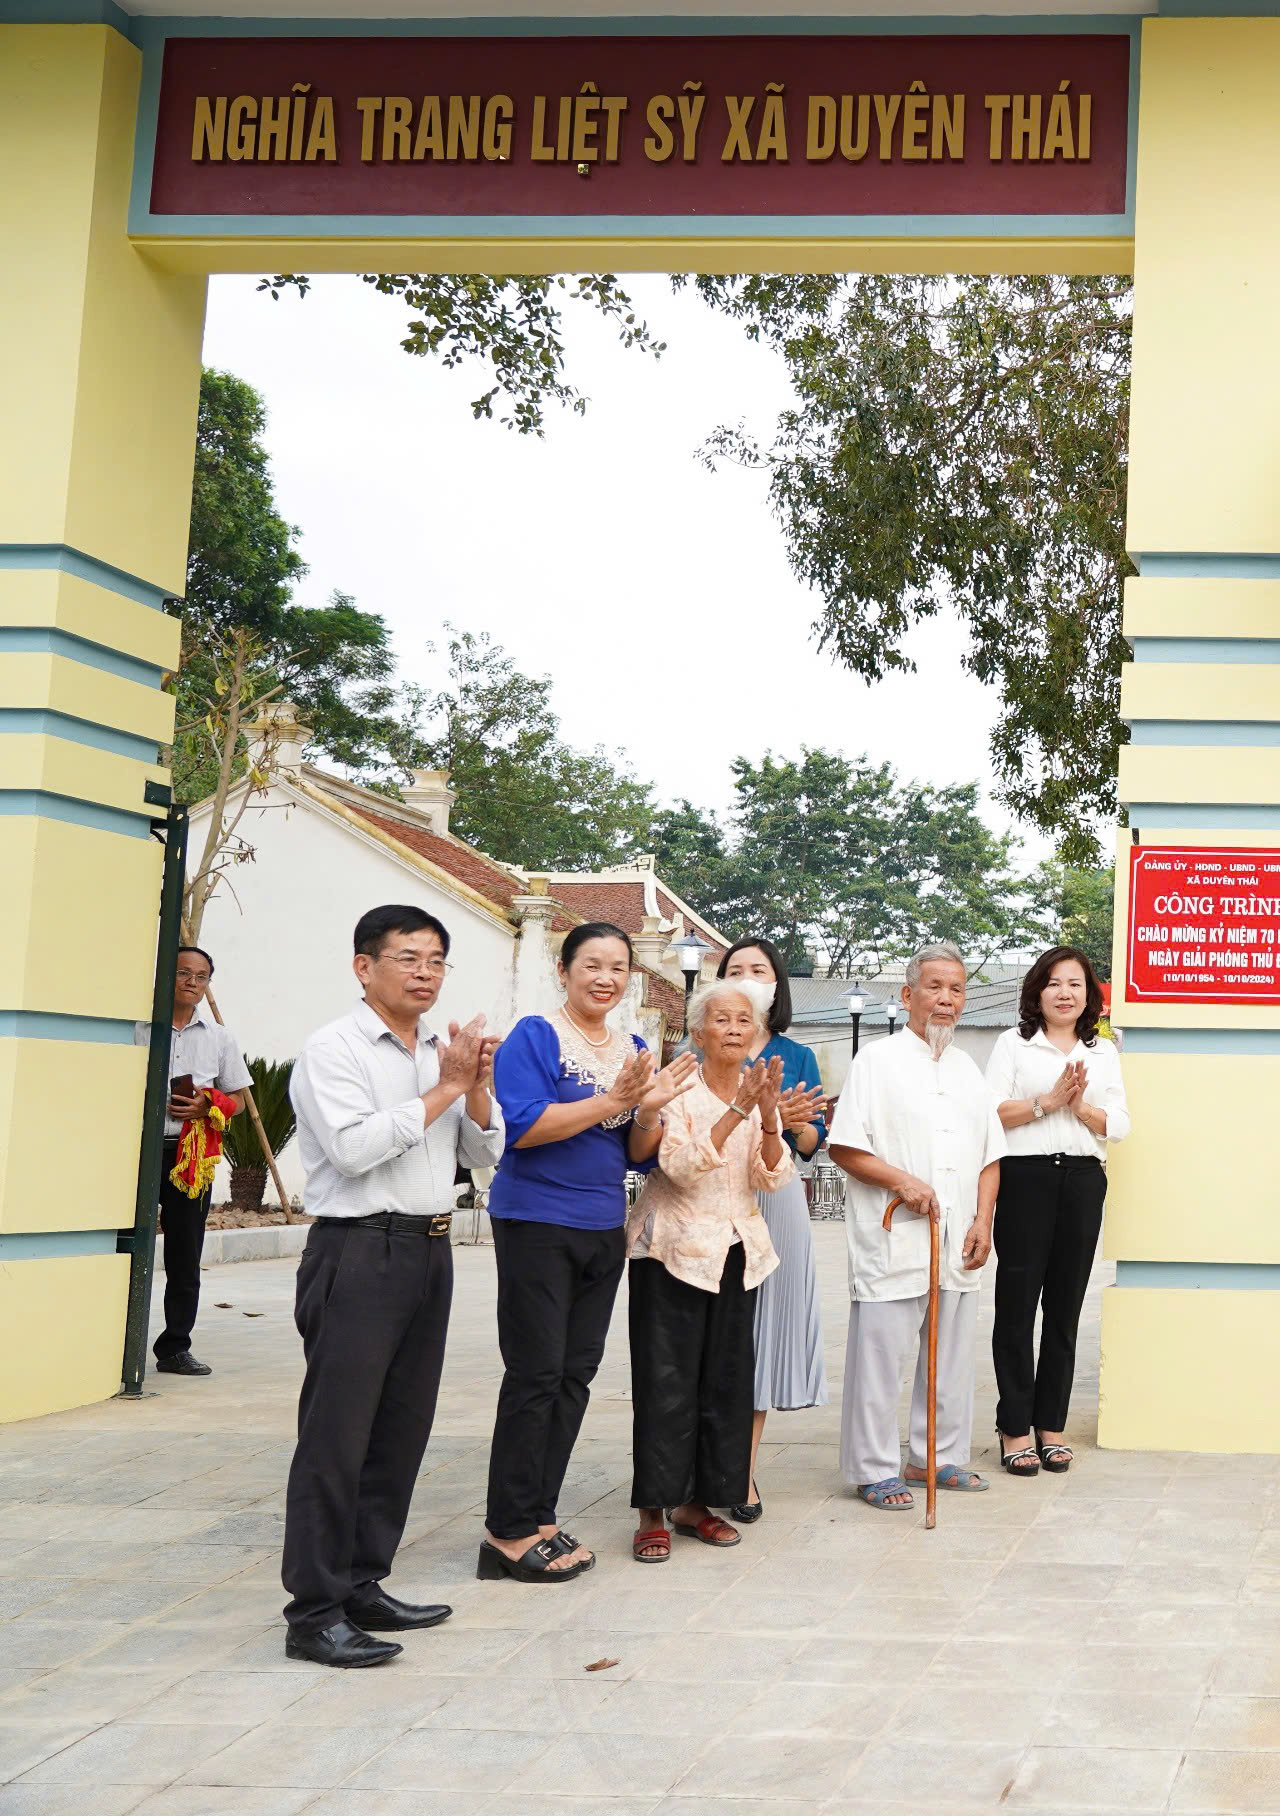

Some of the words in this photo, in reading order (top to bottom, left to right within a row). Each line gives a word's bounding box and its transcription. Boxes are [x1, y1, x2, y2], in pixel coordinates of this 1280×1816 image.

[191, 83, 337, 162] NGHĨA
[356, 94, 516, 162] TRANG
[530, 81, 628, 174] LIỆT
[644, 80, 706, 162] SỸ
[720, 82, 788, 161] XÃ
[806, 80, 966, 162] DUYÊN
[984, 80, 1092, 160] THÁI
[1144, 860, 1171, 871] ĐẢNG
[1174, 860, 1187, 871] ỦY
[1230, 864, 1255, 872] UBND
[1187, 875, 1201, 884] XÃ
[1203, 875, 1235, 885] DUYÊN
[1237, 875, 1259, 885] THÁI
[1154, 892, 1215, 914] CÔNG
[1137, 924, 1168, 941] CHÀO
[1171, 924, 1206, 942] MỪNG
[1209, 922, 1225, 943] KỶ
[1227, 925, 1257, 947] NIỆM
[1260, 930, 1274, 944] 70
[1148, 948, 1180, 966] NGÀY
[1182, 946, 1206, 967] GIẢI
[1209, 950, 1248, 968] PHÓNG
[1252, 947, 1272, 968] THỦ
[1163, 974, 1215, 982] (10/10/1954
[1223, 974, 1274, 984] 10/10/2024)
